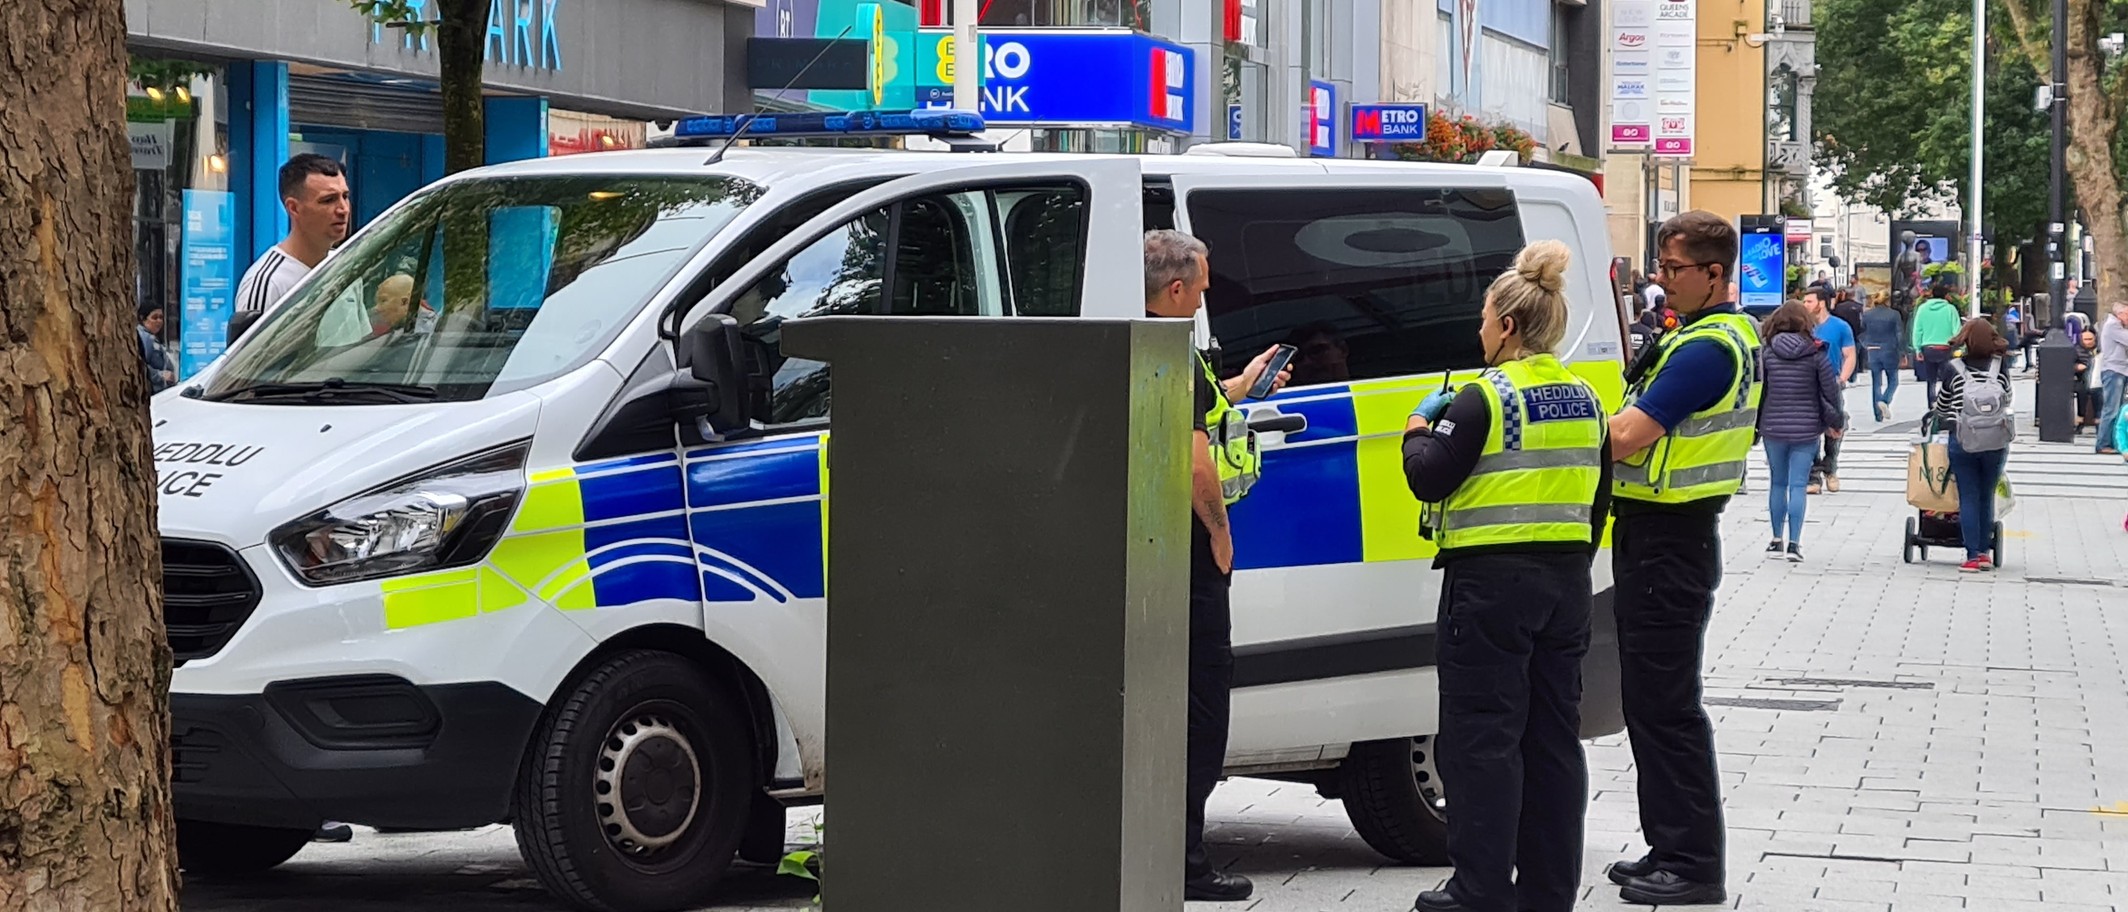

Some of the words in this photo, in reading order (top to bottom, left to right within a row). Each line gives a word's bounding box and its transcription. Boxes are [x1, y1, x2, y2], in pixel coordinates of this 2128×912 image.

[1619, 32, 1646, 43] Argos
[1355, 109, 1419, 135] METRO
[1383, 124, 1418, 134] BANK
[1530, 385, 1586, 402] HEDDLU
[1539, 402, 1589, 419] POLICE
[153, 442, 265, 467] EDDLU
[156, 470, 224, 497] ICE
